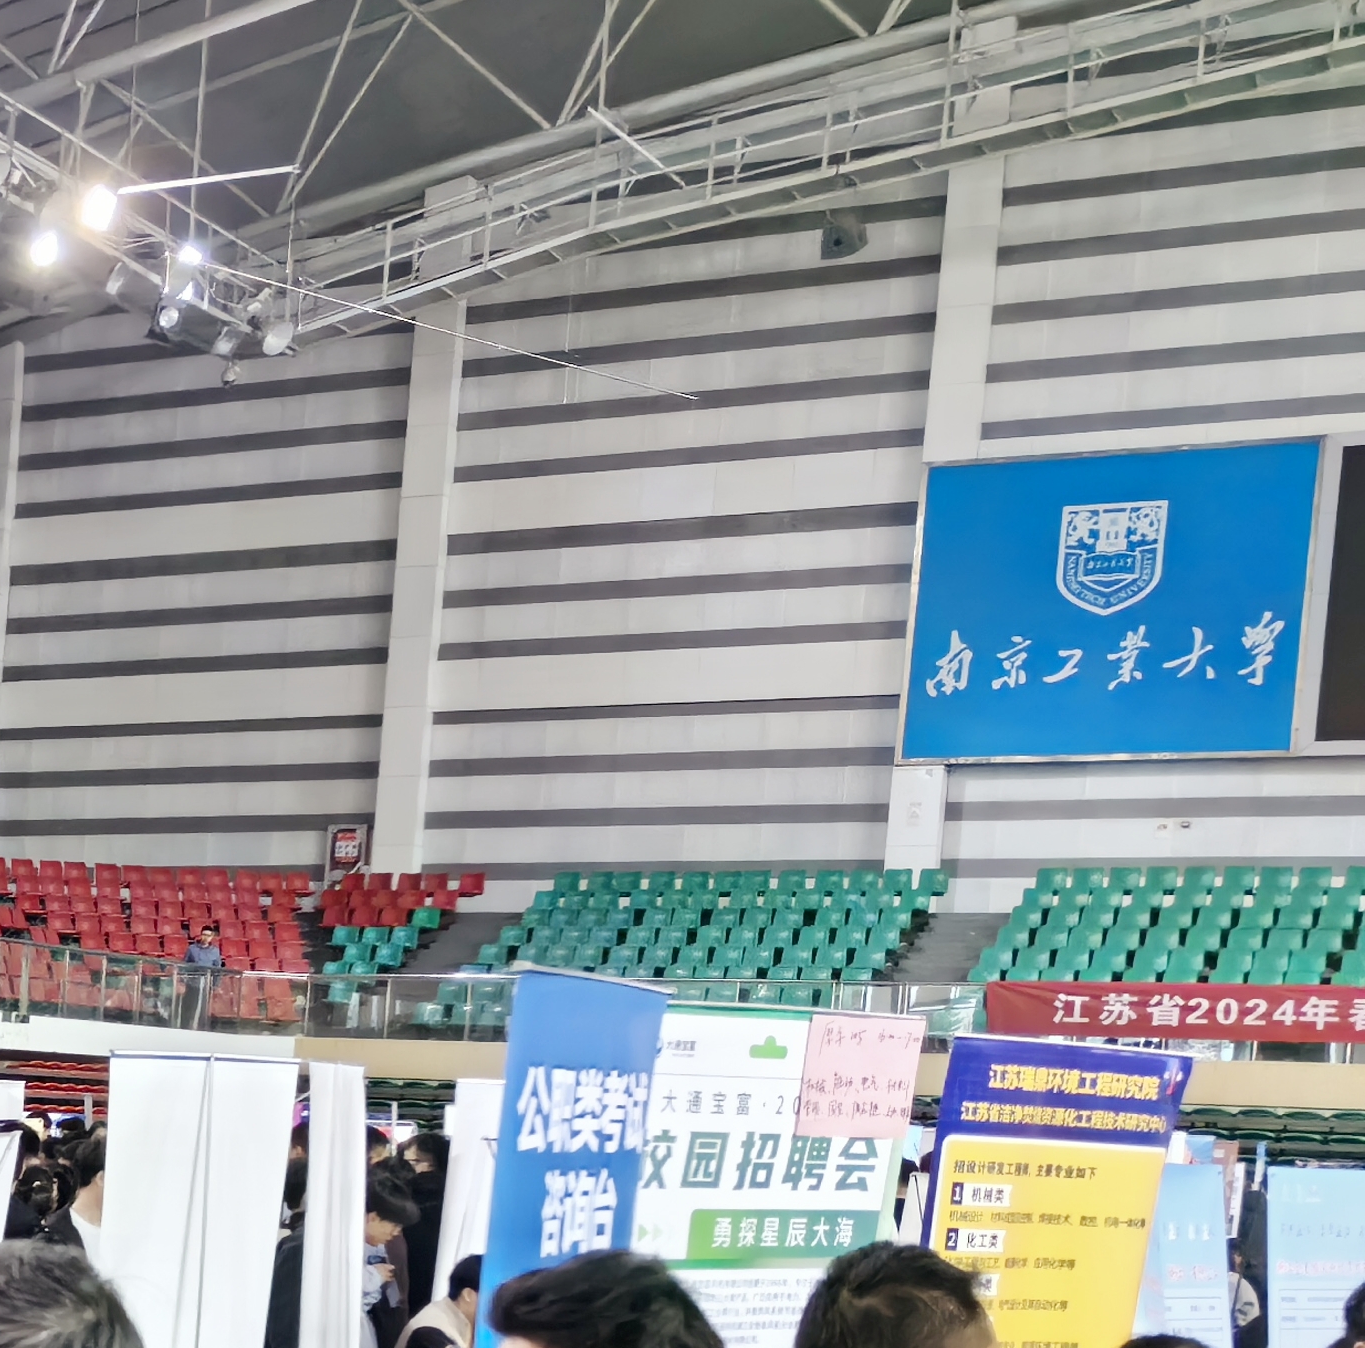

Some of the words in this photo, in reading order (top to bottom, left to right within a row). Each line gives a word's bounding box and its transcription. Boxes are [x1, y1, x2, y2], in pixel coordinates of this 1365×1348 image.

[989, 1063, 1161, 1101] 江苏瑞鼎环境工程研究院
[517, 1066, 649, 1154] 公职类考试
[641, 1129, 879, 1191] 校园招聘会
[541, 1168, 617, 1258] 咨询台
[971, 1187, 1005, 1204] 机械类
[712, 1217, 855, 1248] 勇探星辰大海
[947, 1232, 956, 1247] 2
[966, 1232, 999, 1249] 化工类
